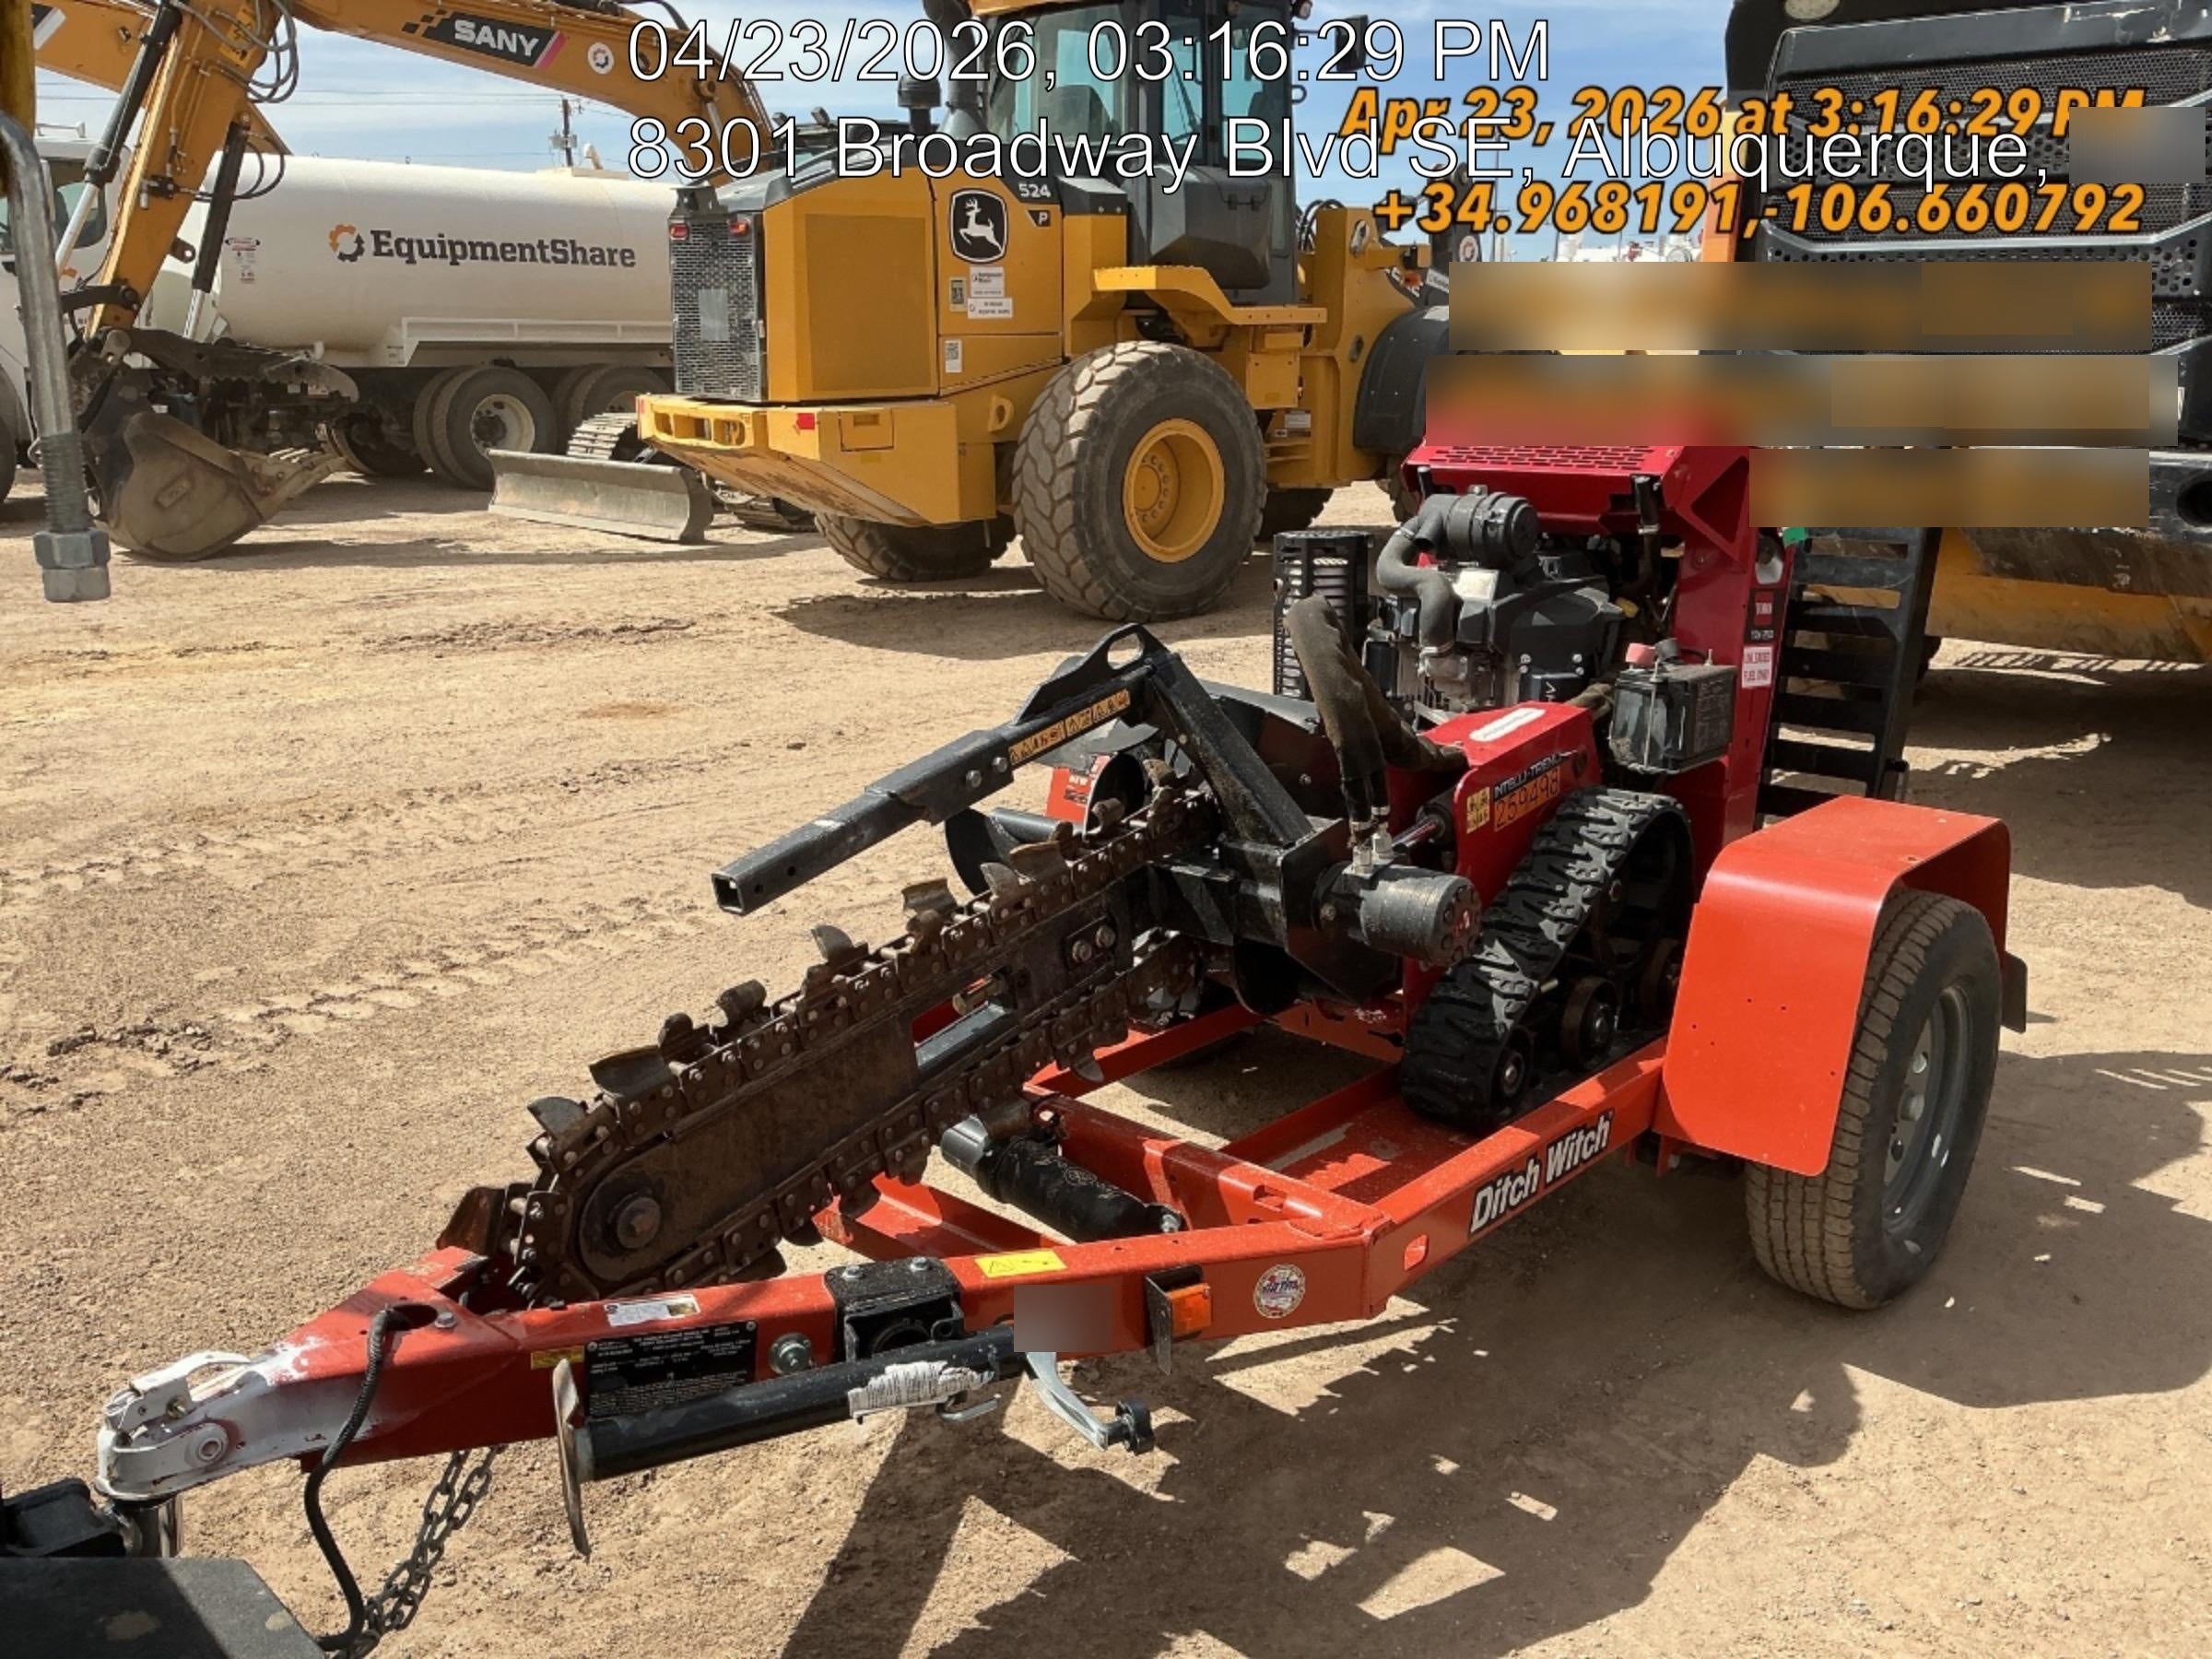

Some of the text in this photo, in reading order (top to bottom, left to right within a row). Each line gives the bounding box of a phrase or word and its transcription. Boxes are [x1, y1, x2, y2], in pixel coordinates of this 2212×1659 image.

[454, 19, 538, 56] SANY
[1018, 183, 1052, 198] 524
[1039, 211, 1049, 226] P
[370, 229, 636, 267] EquipmentShare
[1470, 1114, 1611, 1233] Ditch Witch
